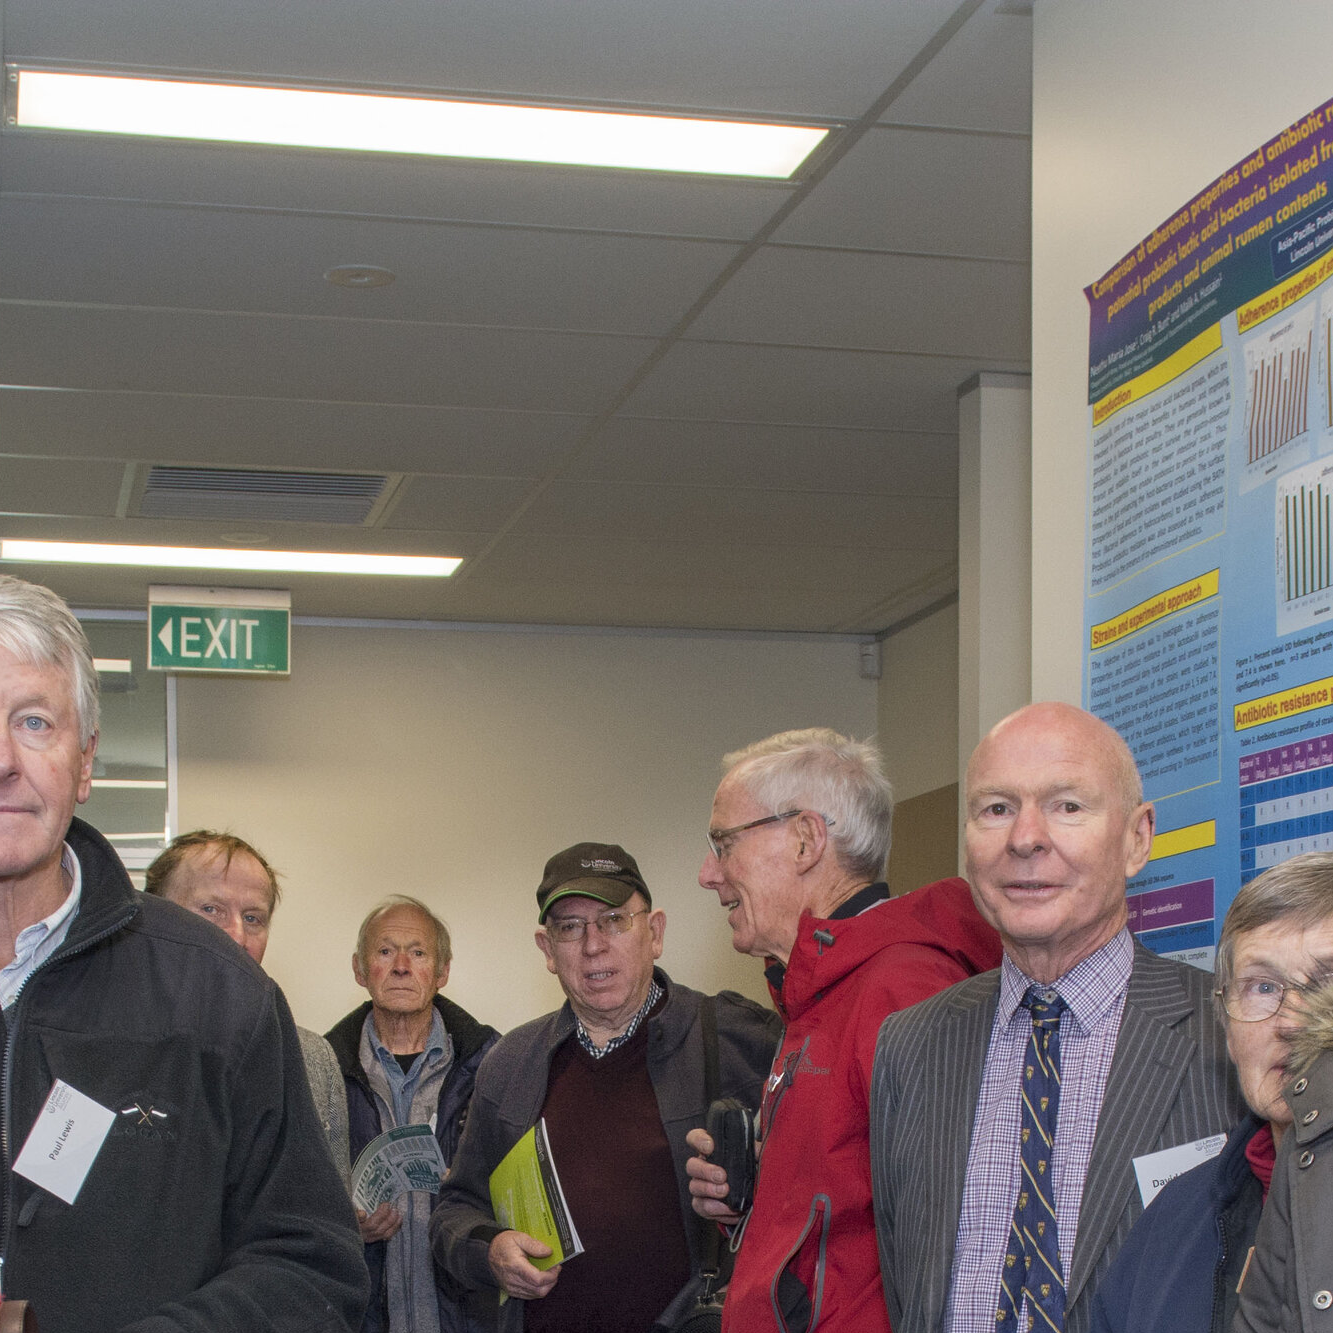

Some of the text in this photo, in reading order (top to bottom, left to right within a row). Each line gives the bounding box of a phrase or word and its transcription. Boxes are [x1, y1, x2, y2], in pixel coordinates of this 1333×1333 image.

[1091, 255, 1137, 299] Comparison
[1147, 210, 1190, 253] adherence
[1190, 170, 1239, 223] properties
[1242, 147, 1265, 179] and
[1267, 112, 1324, 161] antibiotic
[1107, 276, 1141, 323] potential
[1142, 252, 1178, 295] probiotic
[1178, 232, 1200, 260] lactic
[1201, 213, 1219, 242] acid
[1220, 185, 1267, 226] bacteria
[1269, 145, 1318, 195] isolated
[1148, 180, 1327, 321] products and animal rumen contents
[1239, 296, 1279, 328] Adherence
[1281, 270, 1317, 307] properties
[1095, 389, 1131, 422] Introduction
[181, 616, 259, 660] EXIT
[1093, 583, 1201, 645] Strains and experimental approach
[1236, 701, 1278, 726] Antibiotic
[1280, 690, 1328, 714] resistance
[48, 1141, 63, 1160] Paul
[59, 1119, 75, 1142] Lewis
